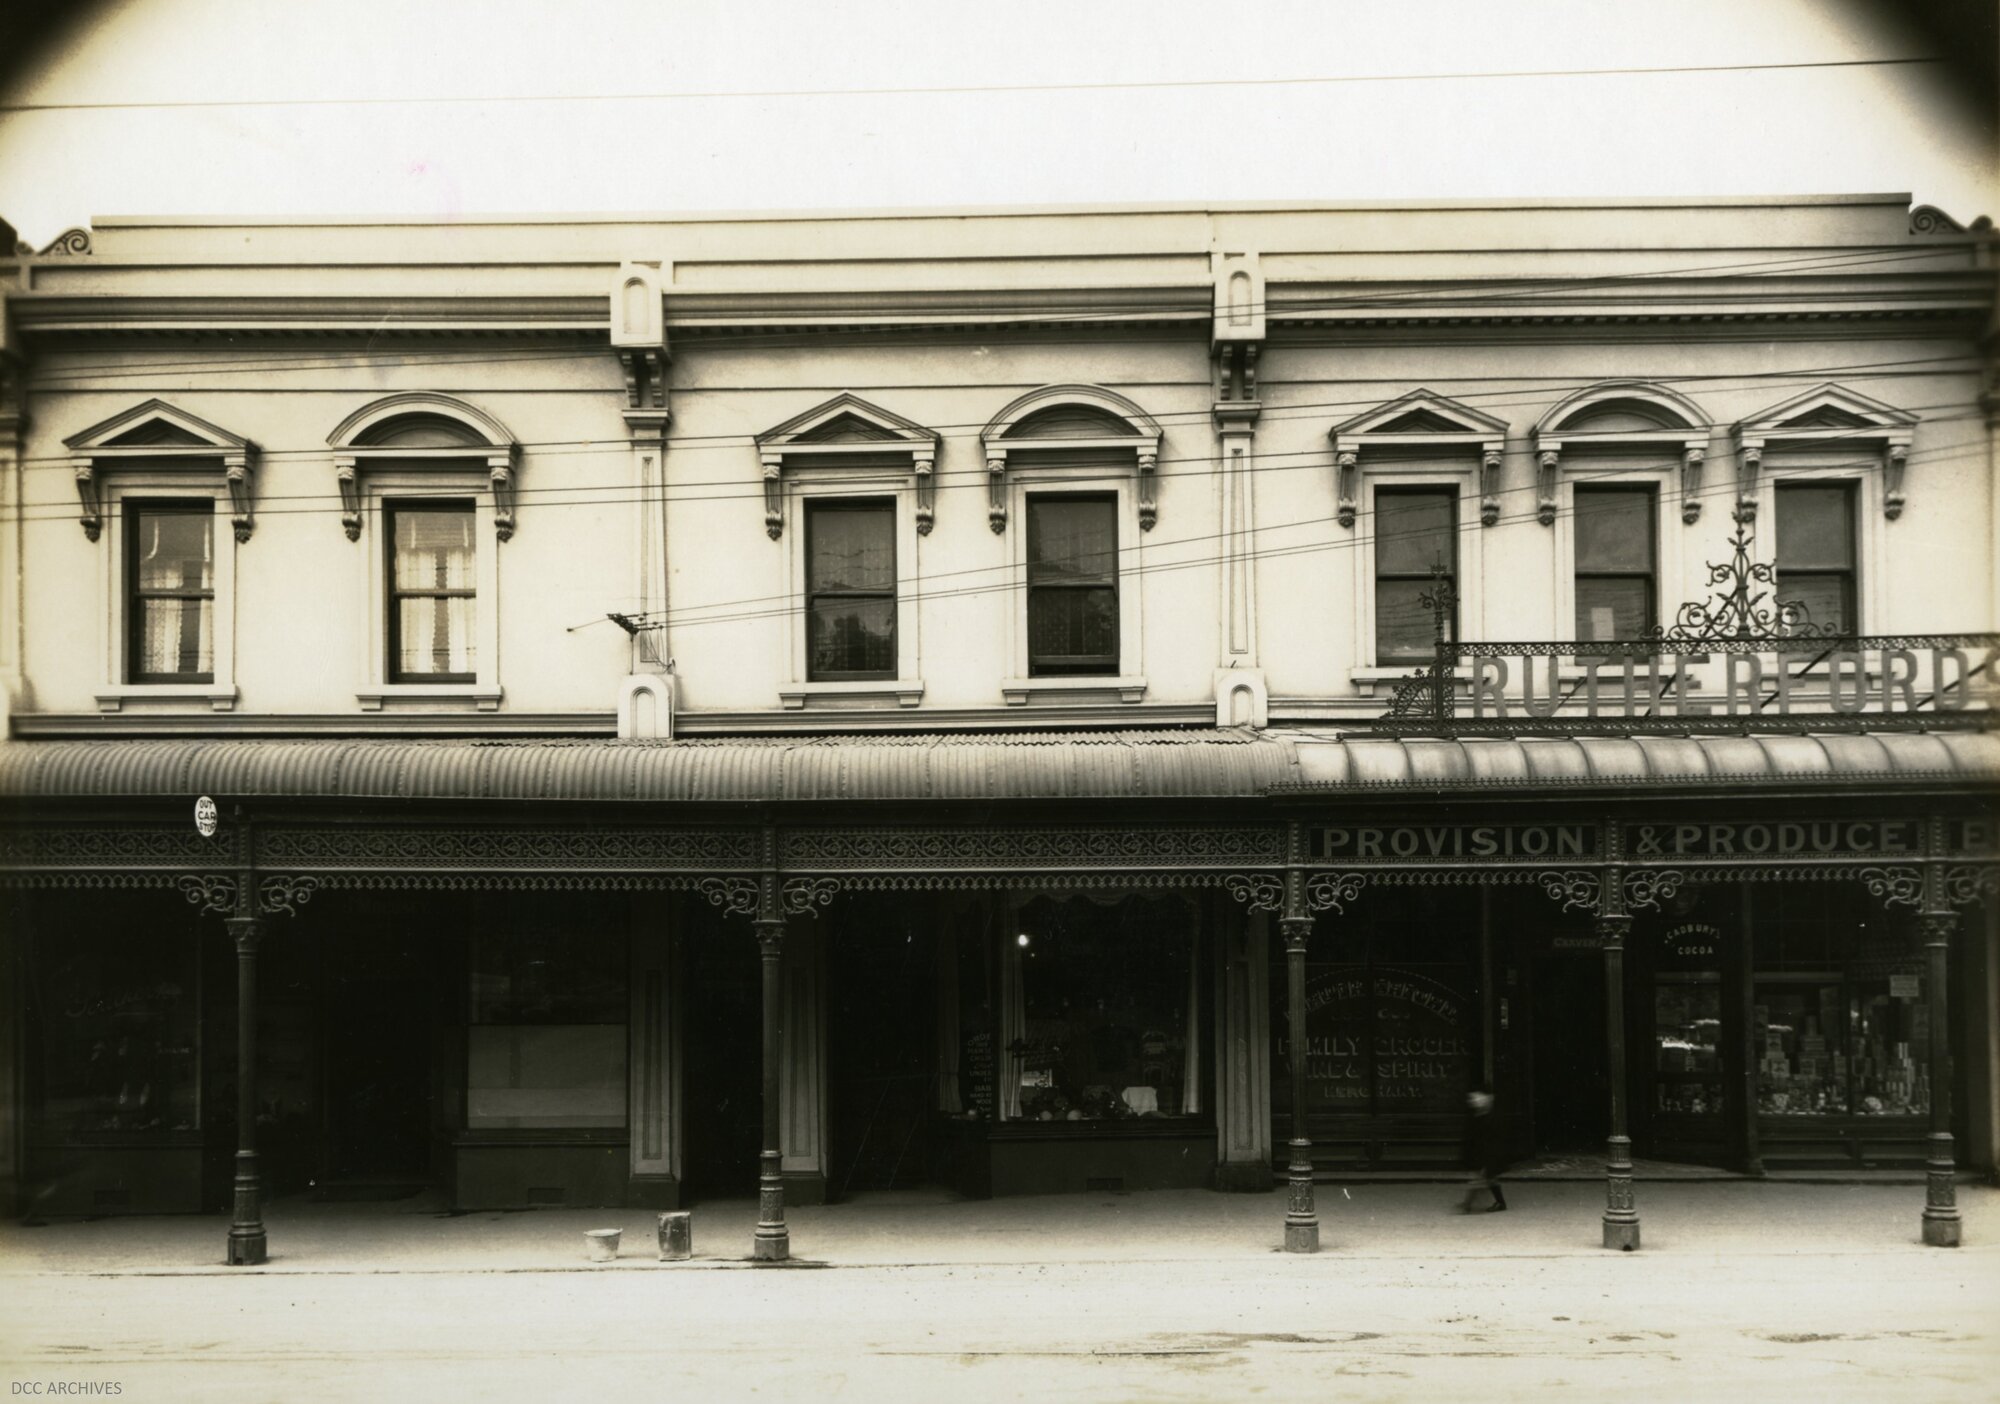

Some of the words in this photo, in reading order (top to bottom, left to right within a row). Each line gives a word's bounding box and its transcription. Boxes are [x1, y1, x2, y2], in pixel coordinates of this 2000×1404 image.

[198, 811, 217, 821] CAR
[1323, 826, 1583, 857] PROVISION
[1677, 945, 1714, 956] COCOA
[1277, 1036, 1361, 1056] FMILY
